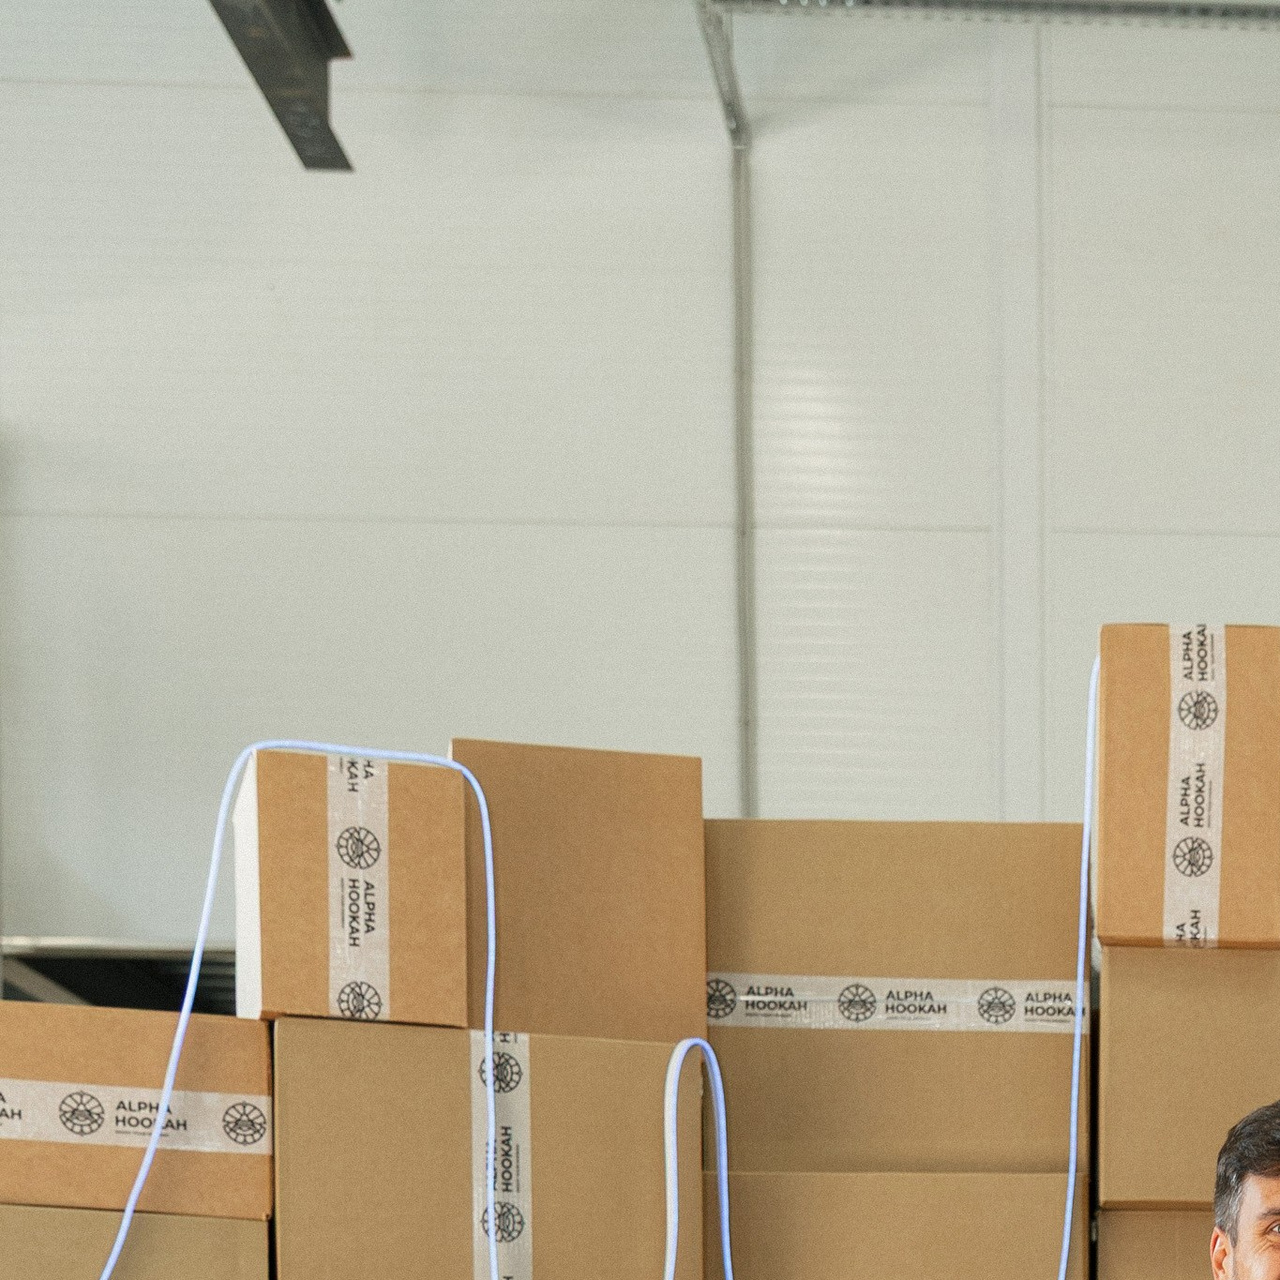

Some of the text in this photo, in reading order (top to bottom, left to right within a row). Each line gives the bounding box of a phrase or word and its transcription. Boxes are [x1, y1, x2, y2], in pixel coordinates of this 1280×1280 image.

[1182, 631, 1194, 681] ALPHA
[1180, 775, 1192, 826] ALPHA
[1194, 762, 1206, 828] HOOKAH
[349, 878, 360, 947] HOOKAH
[363, 880, 375, 934] ALPHA
[746, 985, 794, 998] ALPHA
[746, 1000, 807, 1012] HOOKAH
[886, 989, 934, 1002] ALPHA
[1025, 991, 1073, 1004] ALPHA
[885, 1003, 947, 1015] HOOKAH
[115, 1115, 188, 1131] HOOAH
[501, 1126, 512, 1193] HOOKAH
